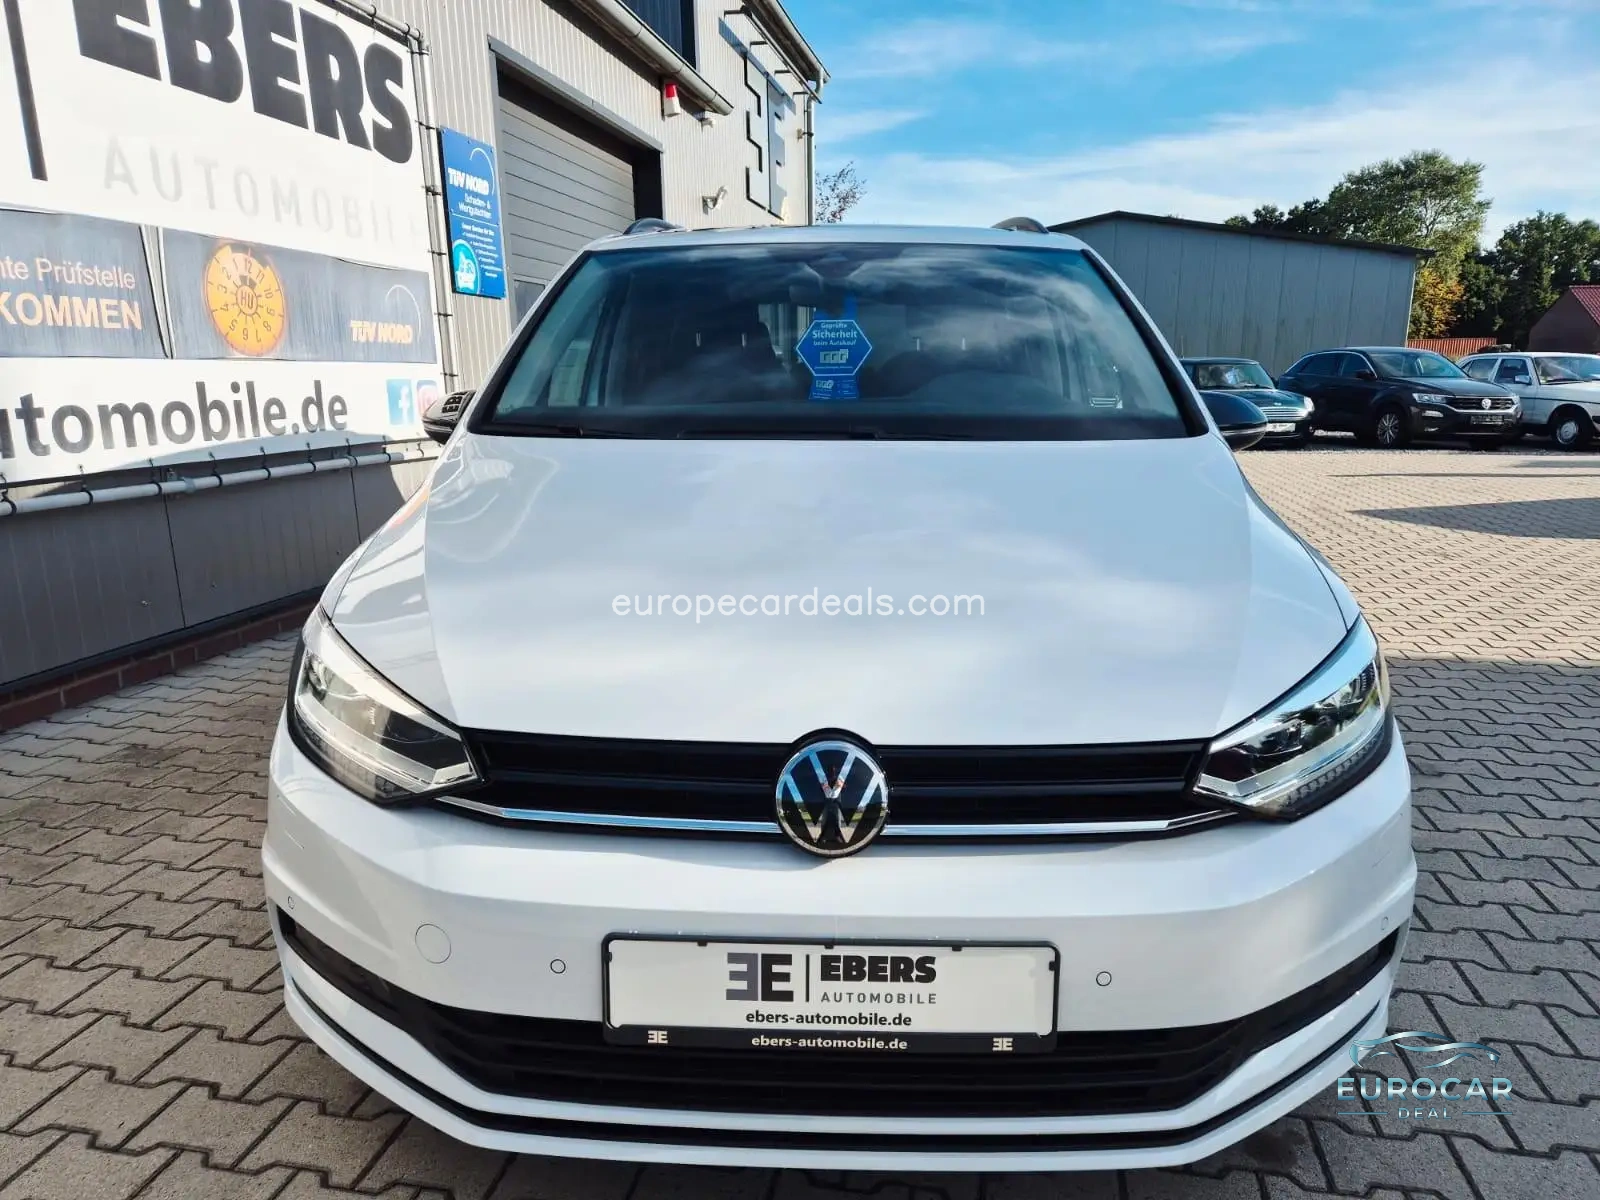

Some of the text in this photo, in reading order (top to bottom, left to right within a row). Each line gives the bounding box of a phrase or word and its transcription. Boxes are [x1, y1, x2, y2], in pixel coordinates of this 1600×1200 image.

[35, 257, 136, 289] Prüfstelle
[812, 330, 858, 339] Sicherheit
[820, 954, 937, 984] EBERS
[820, 991, 937, 1005] AUTOMOBILE
[745, 1009, 913, 1027] ebers-automobile.de
[751, 1035, 908, 1050] ebers-automobile.de
